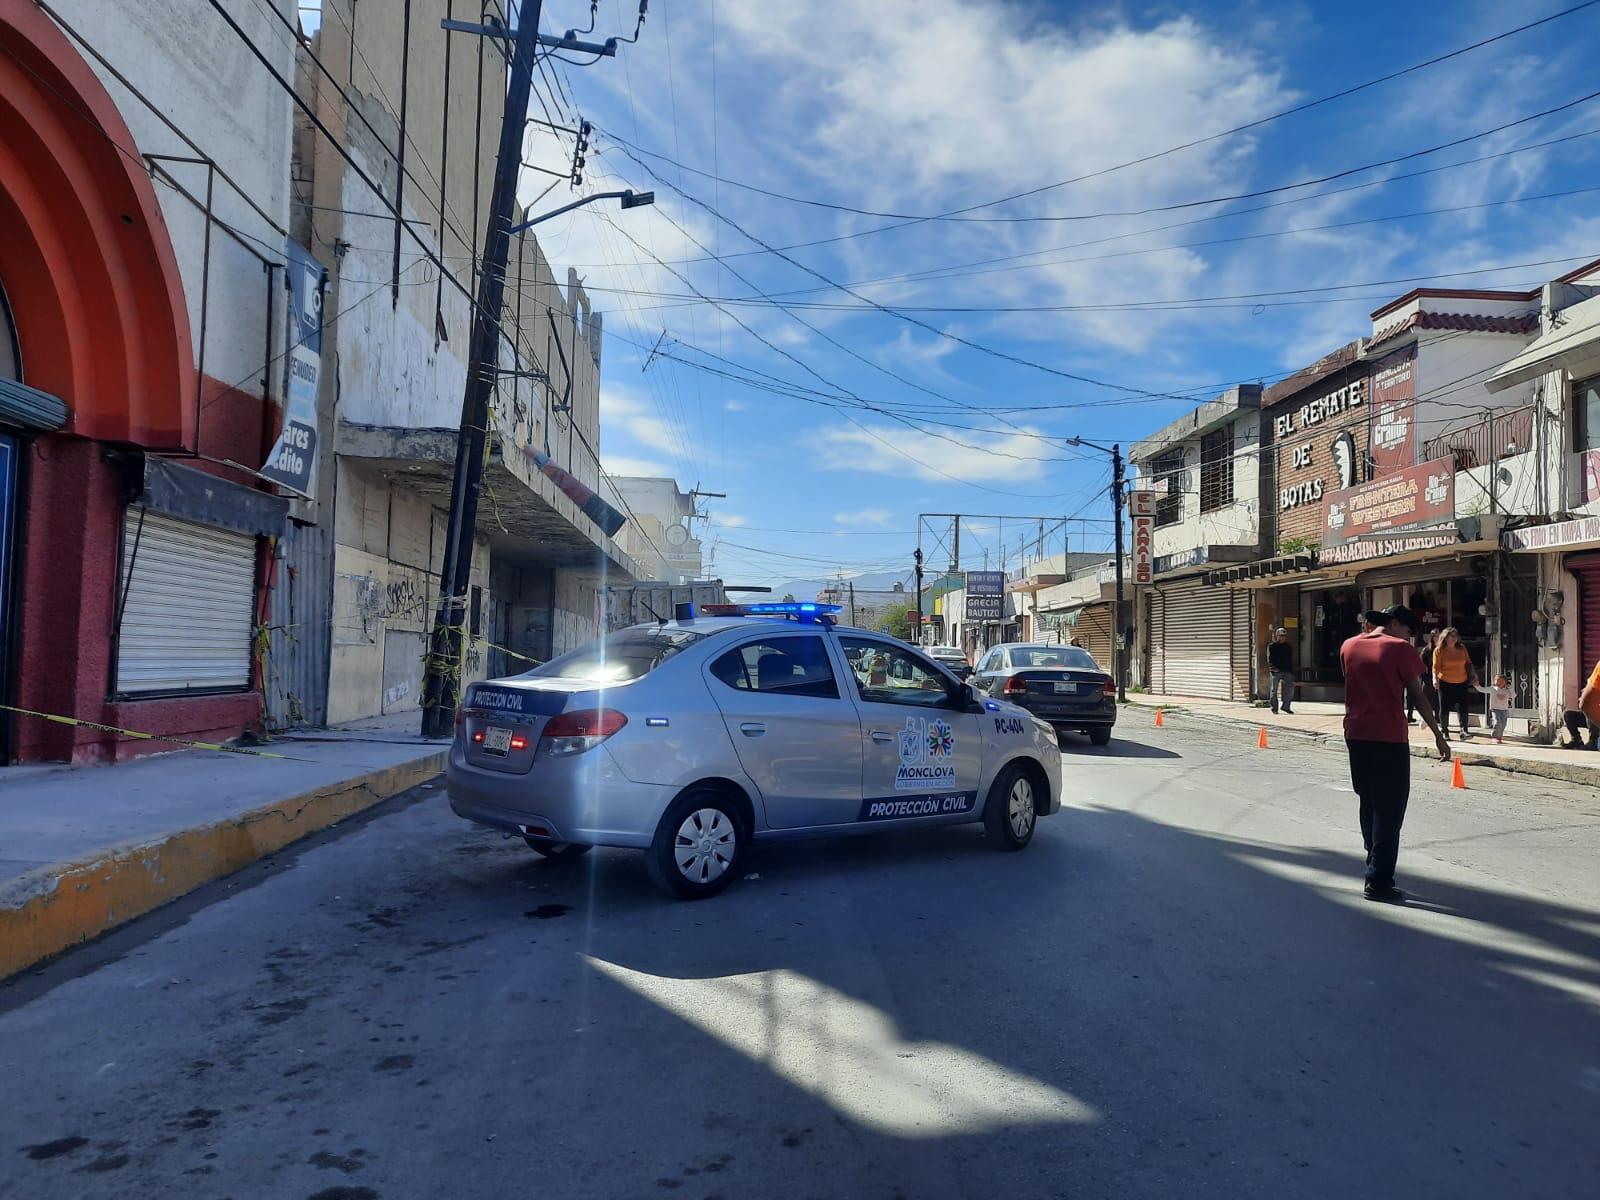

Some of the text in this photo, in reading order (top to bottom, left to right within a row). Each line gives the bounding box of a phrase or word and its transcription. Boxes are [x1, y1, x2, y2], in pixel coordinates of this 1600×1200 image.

[1277, 380, 1361, 437] EL REMATE
[1375, 415, 1408, 446] Grande
[273, 446, 304, 475] dito
[1292, 443, 1311, 468] DE
[1137, 493, 1151, 513] EL
[1279, 479, 1323, 508] BOTAS
[1349, 479, 1418, 511] FRONTERA
[1351, 496, 1416, 526] WESTERN
[1549, 524, 1559, 545] EN
[1561, 521, 1582, 543] ROPA
[1137, 518, 1150, 582] PARAISO
[967, 608, 1000, 617] BAUTIZO
[474, 689, 523, 710] PROTECCIÓN CIVIL
[994, 718, 1024, 734] PC-404
[897, 766, 955, 778] MONCLOVA
[869, 796, 967, 817] PROTECCIÓN CIVIL
